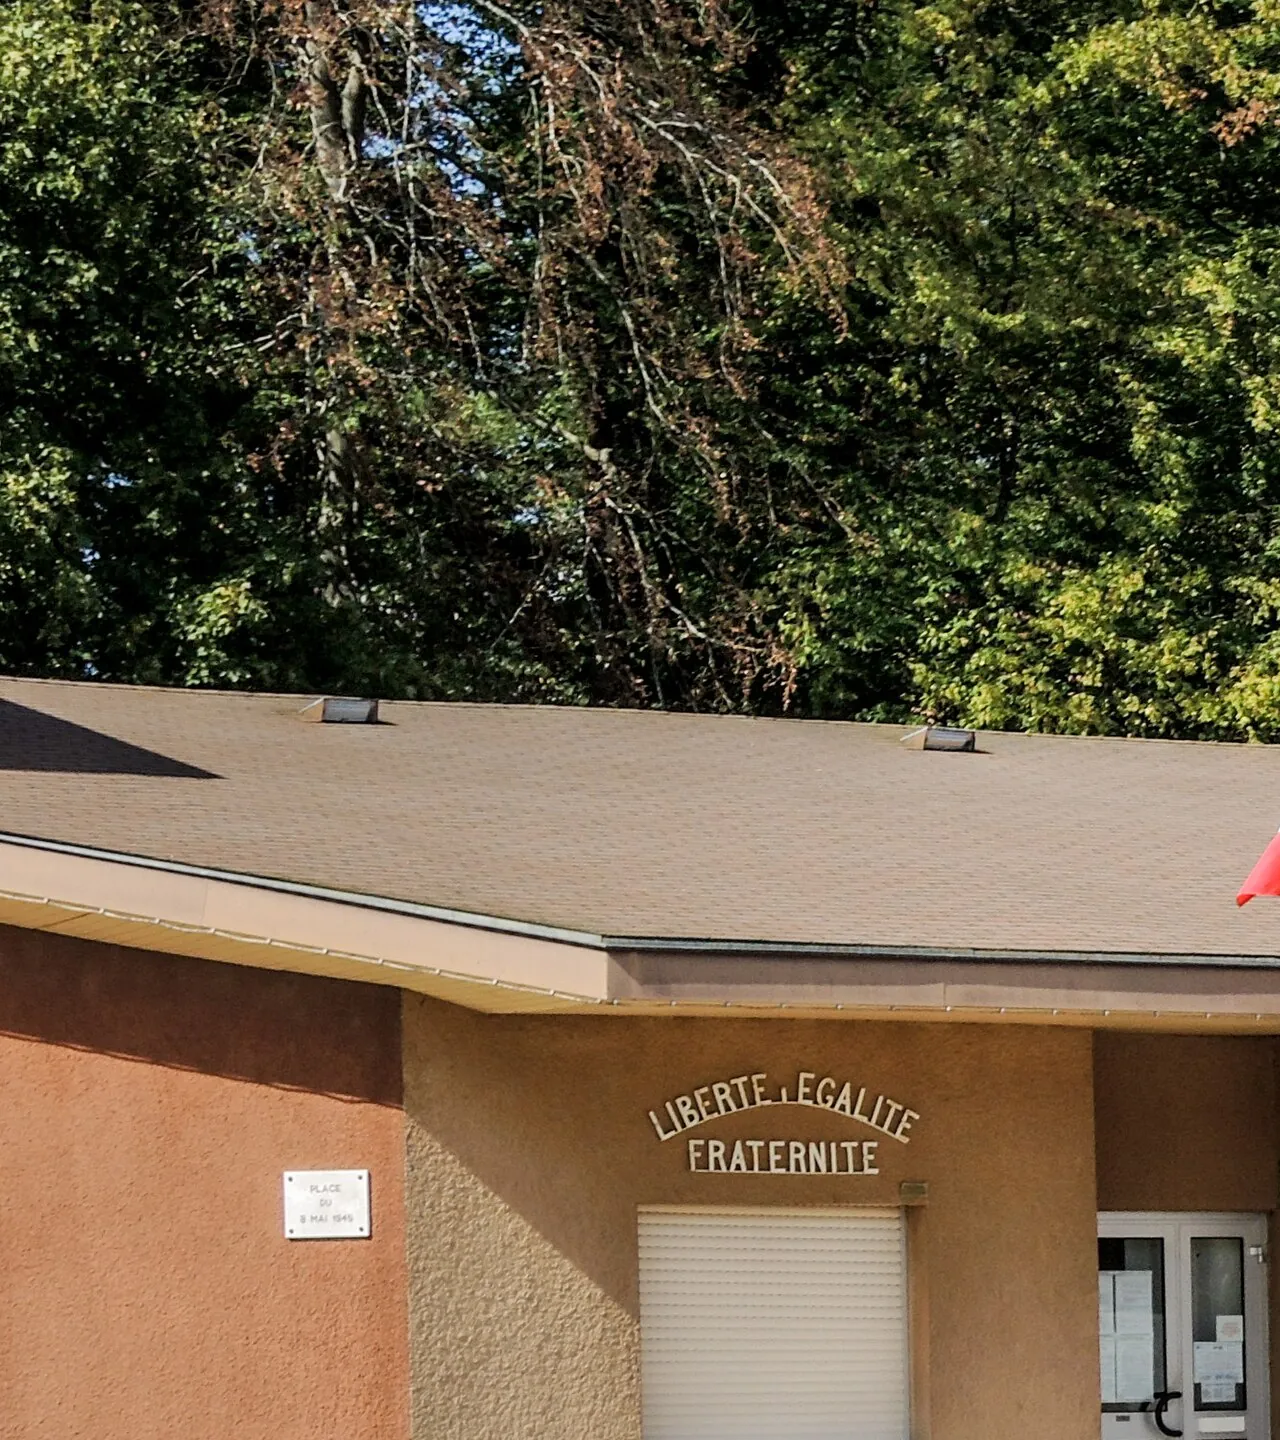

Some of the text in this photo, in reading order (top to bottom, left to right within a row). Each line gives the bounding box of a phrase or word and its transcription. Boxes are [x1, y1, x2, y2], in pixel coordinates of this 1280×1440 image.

[797, 1071, 921, 1146] EGALITE
[688, 1139, 880, 1175] FRATERNITE
[310, 1184, 341, 1193] PLACE
[319, 1199, 333, 1207] DU
[299, 1215, 306, 1223] 8
[310, 1214, 328, 1223] MAI
